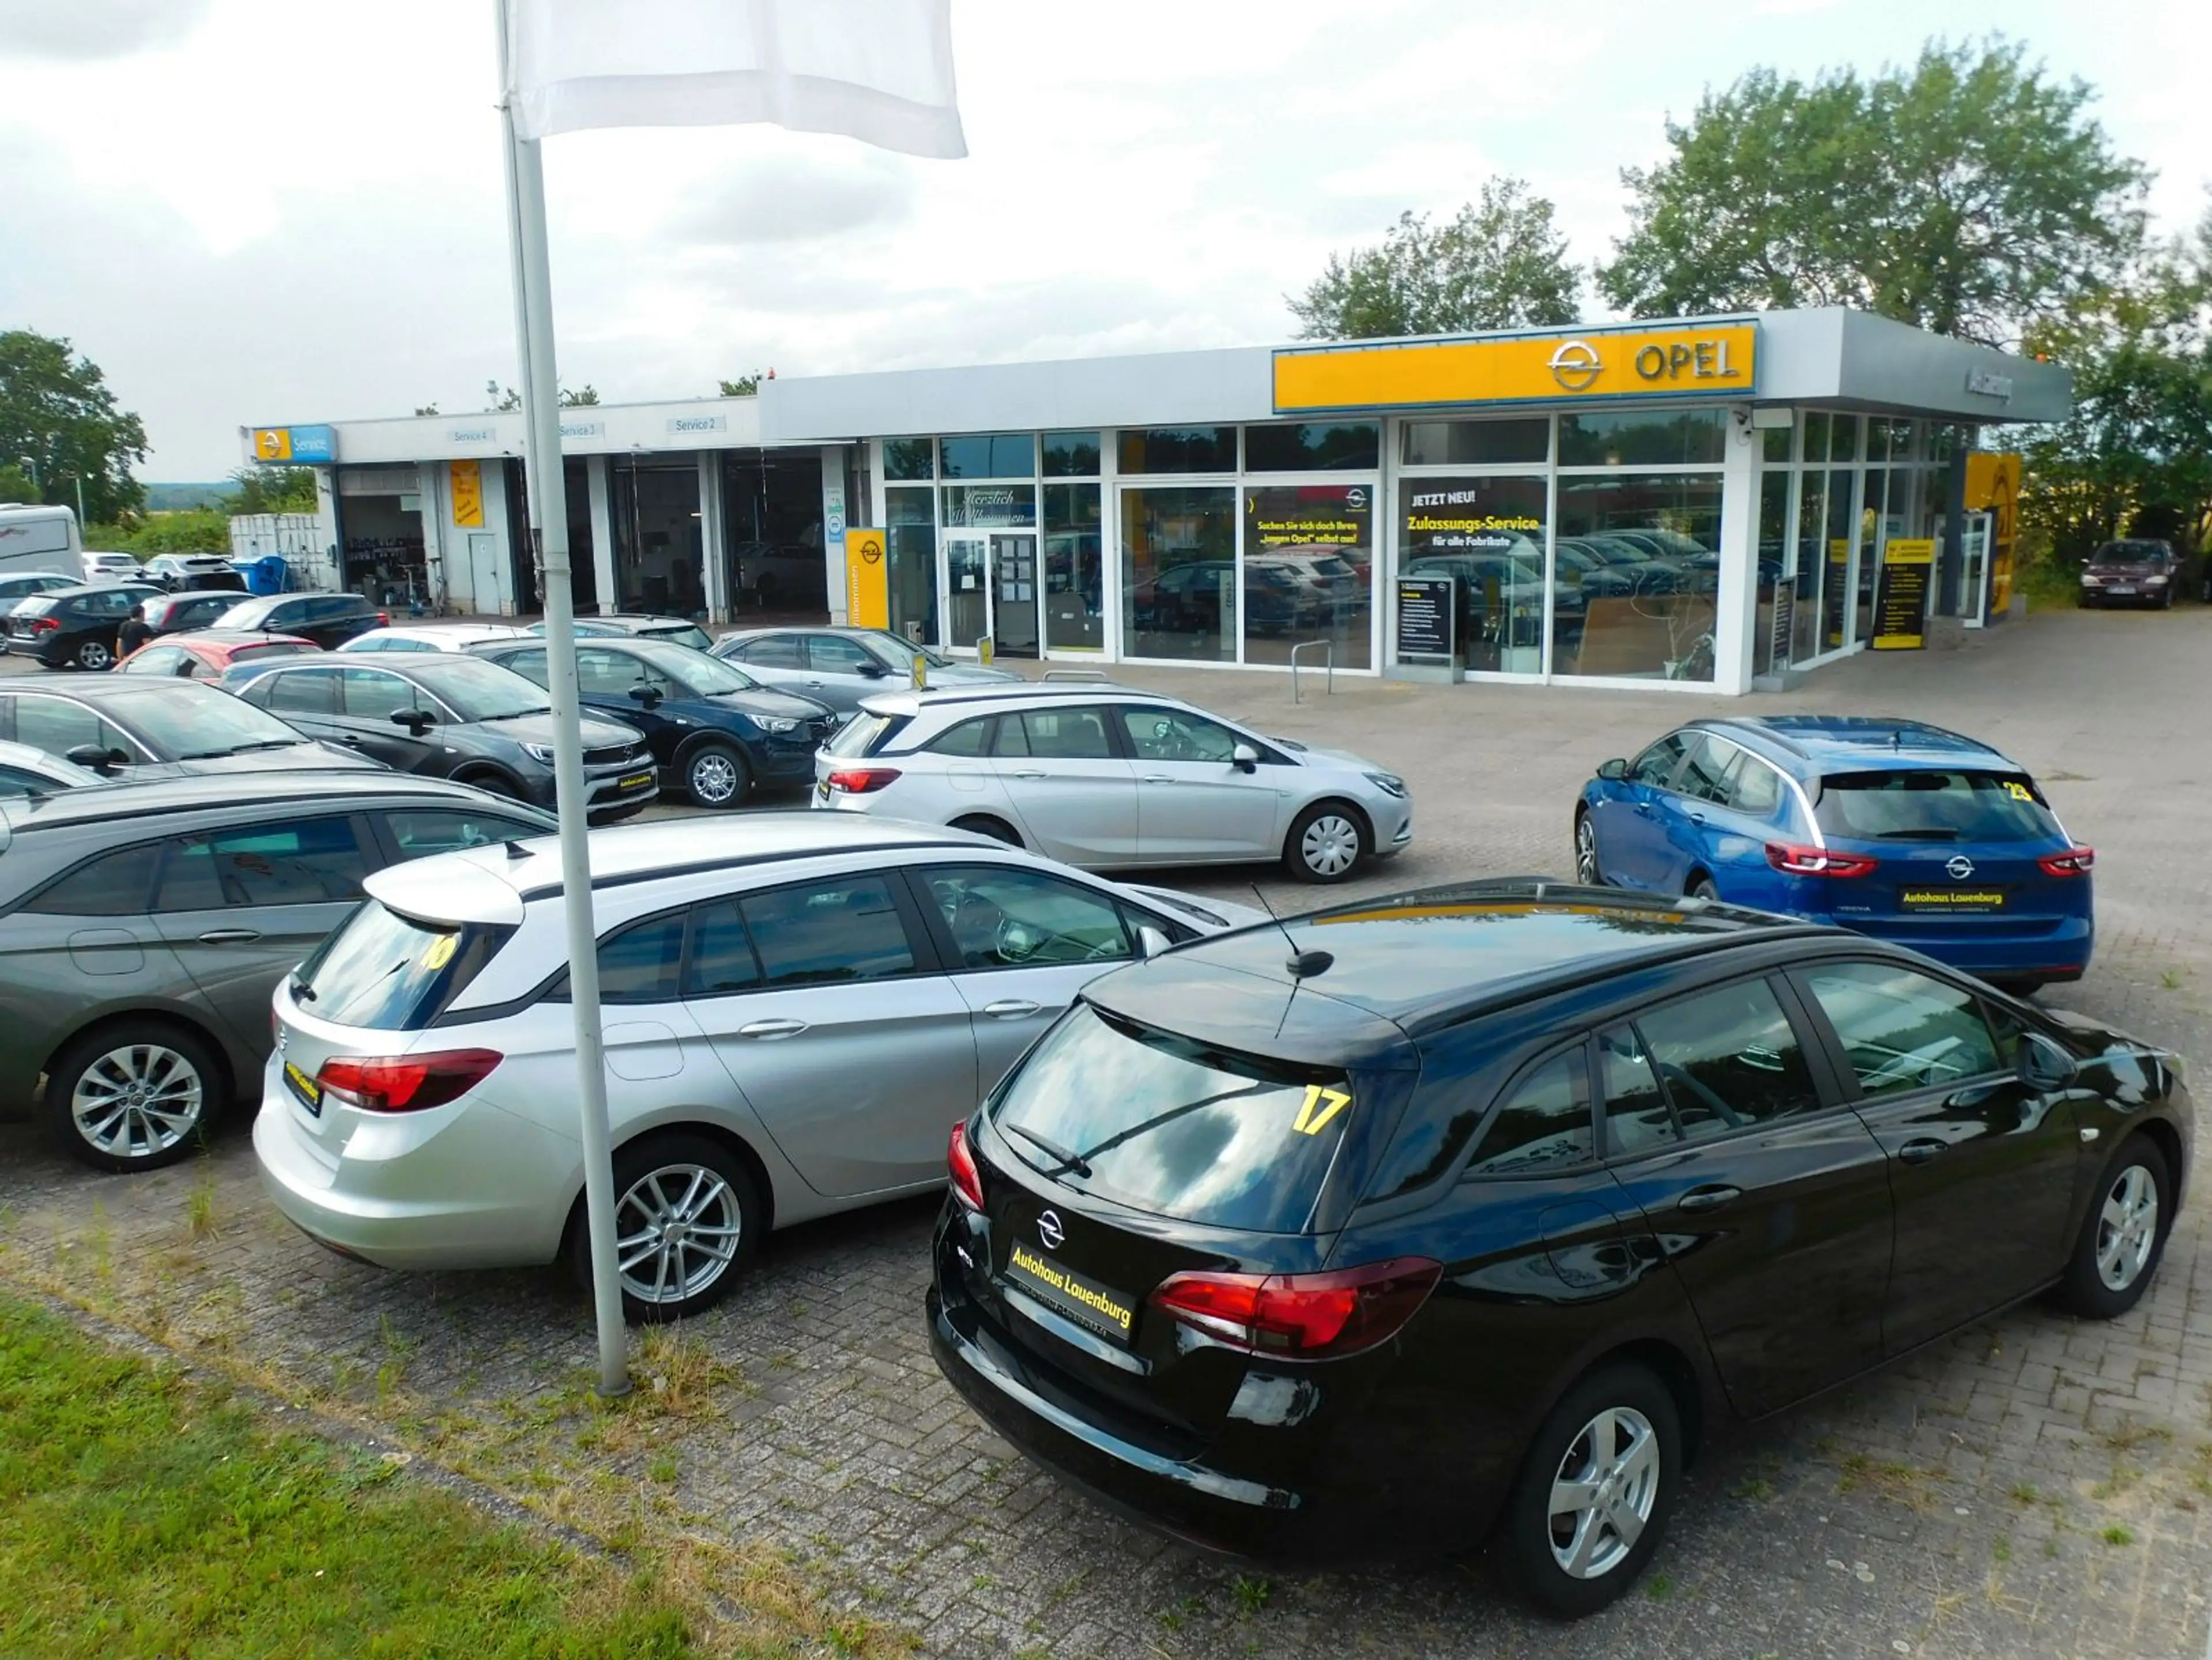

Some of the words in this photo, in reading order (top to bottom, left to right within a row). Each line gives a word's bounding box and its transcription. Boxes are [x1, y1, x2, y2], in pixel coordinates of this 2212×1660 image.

[1636, 339, 1739, 381] OPEL
[676, 418, 708, 431] Service
[710, 417, 715, 429] 2
[454, 431, 481, 442] Service
[963, 489, 1014, 505] Herzlich
[1411, 493, 1446, 507] JETZT
[1448, 490, 1476, 504] NEU!
[1257, 520, 1285, 530] Suchen
[1286, 521, 1298, 530] Sie
[1407, 515, 1540, 534] Zulassungs-Service
[1432, 535, 1446, 546] für
[1447, 535, 1464, 546] alle
[1465, 535, 1511, 546] Fabrikate
[2003, 781, 2032, 802] 23
[1903, 892, 1949, 903] Autohaus
[1951, 892, 2003, 904] Lauenburg
[1292, 1084, 1351, 1135] 17
[1012, 1246, 1064, 1289] Autohaus
[1063, 1274, 1132, 1329] Lauenburg
